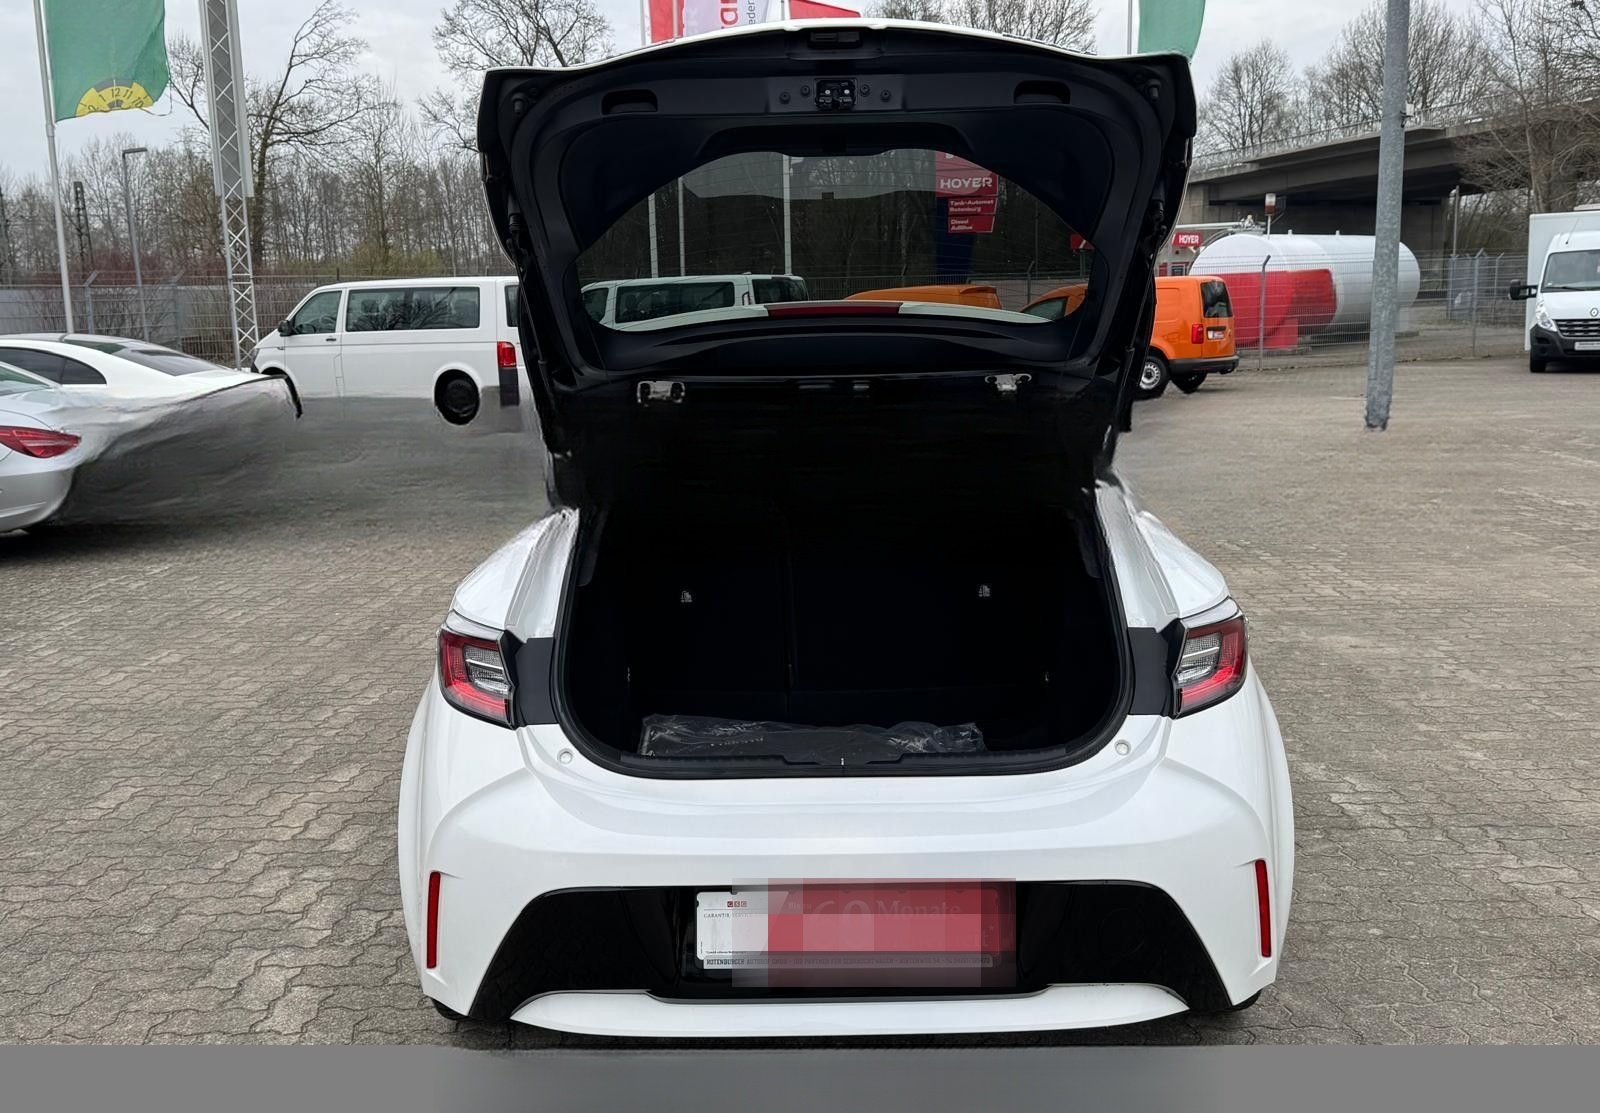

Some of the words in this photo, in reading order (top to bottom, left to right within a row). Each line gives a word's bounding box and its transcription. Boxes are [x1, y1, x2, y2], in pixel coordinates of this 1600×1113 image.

[112, 88, 120, 97] 12
[123, 89, 133, 99] 11
[940, 177, 993, 189] HOYER
[1178, 234, 1200, 245] HOYER
[875, 900, 962, 920] Monate
